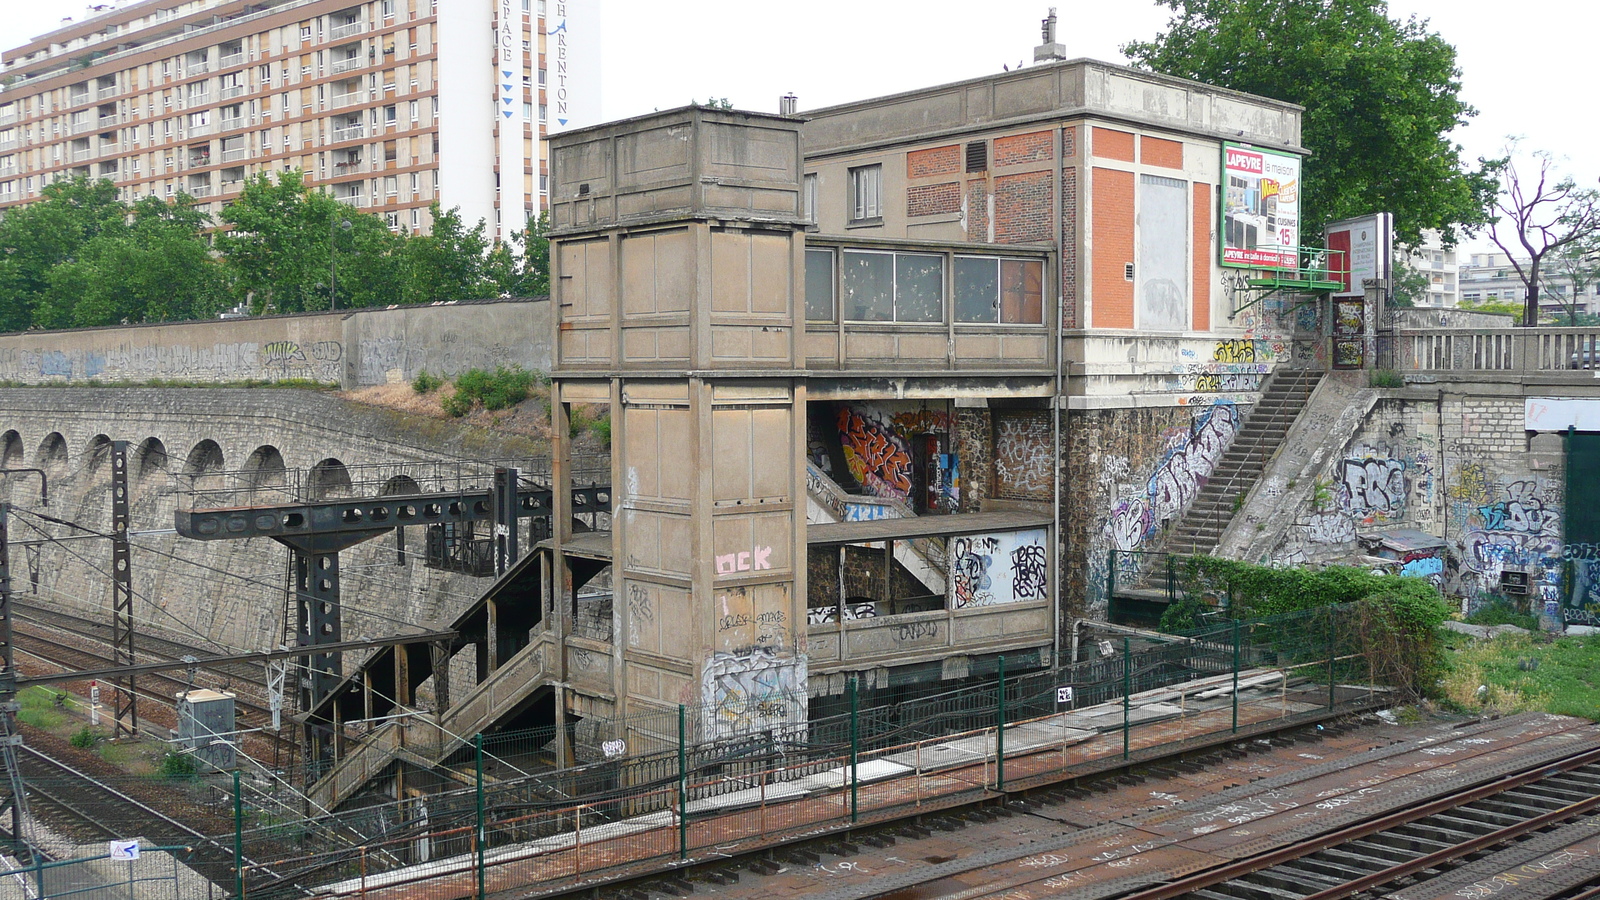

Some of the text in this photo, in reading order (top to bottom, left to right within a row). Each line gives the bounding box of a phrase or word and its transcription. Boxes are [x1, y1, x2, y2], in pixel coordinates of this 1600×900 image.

[555, 0, 567, 114] HARENTON
[1226, 152, 1294, 176] LAPEYRE la maison
